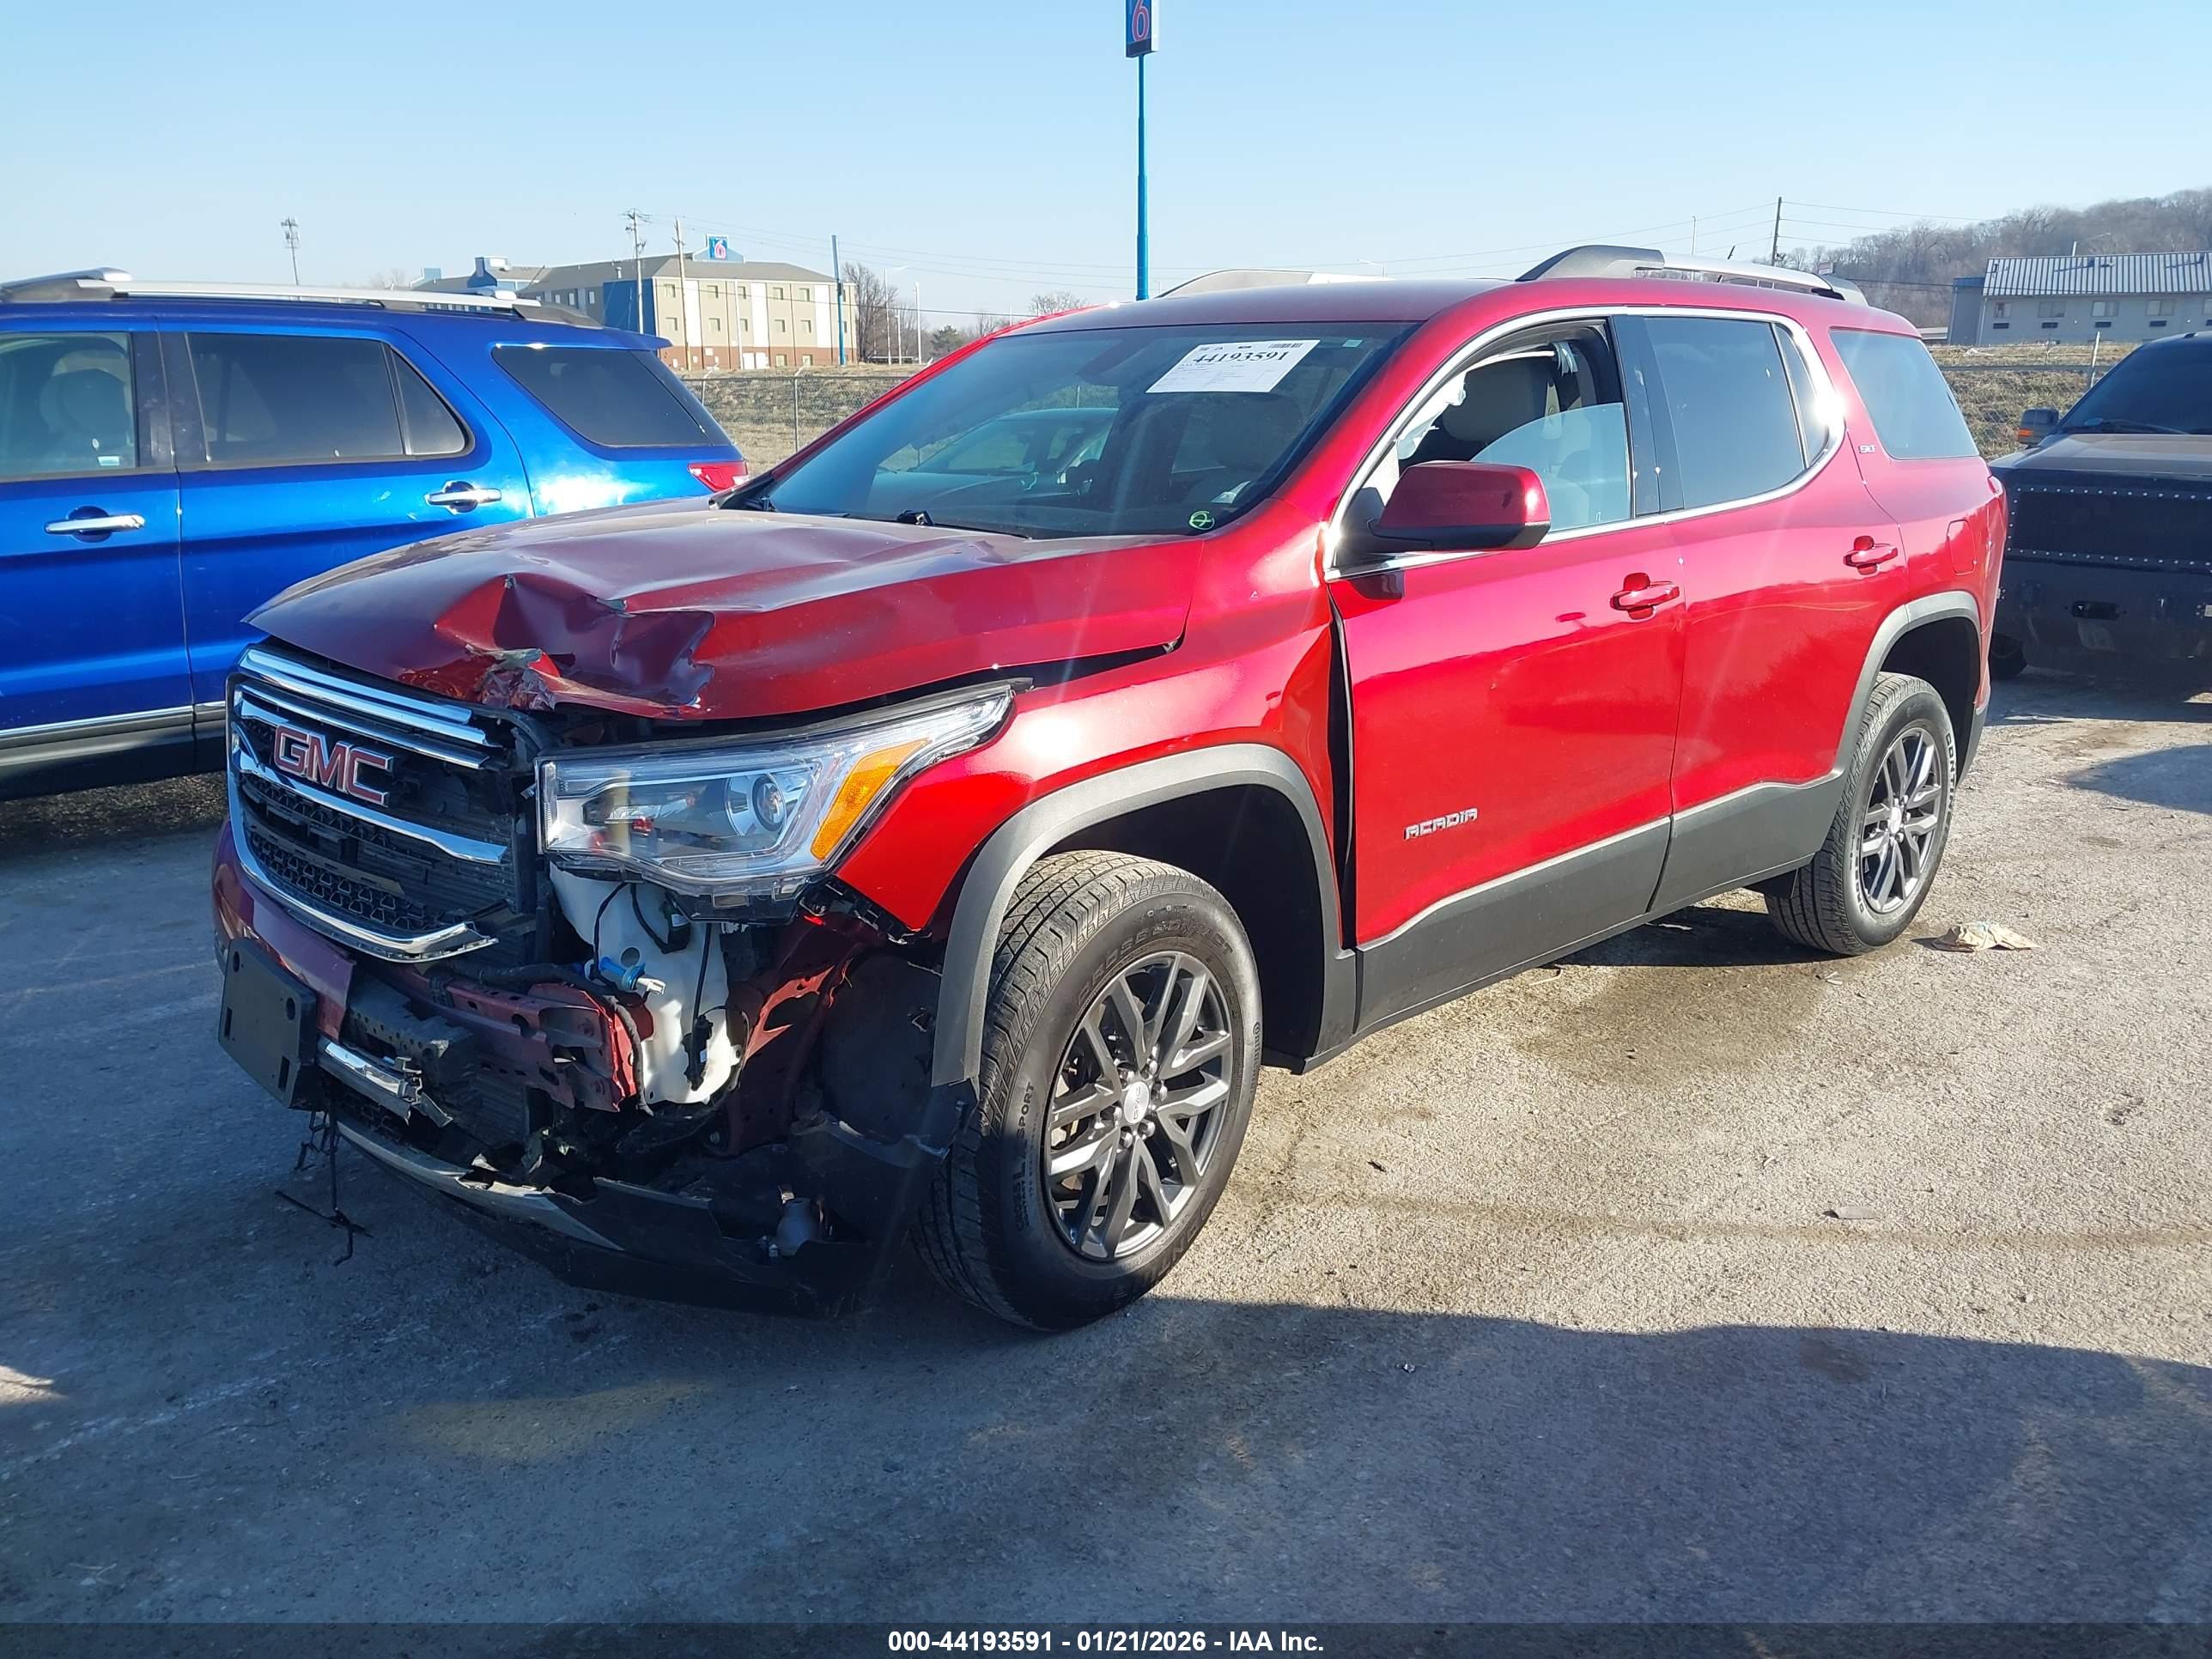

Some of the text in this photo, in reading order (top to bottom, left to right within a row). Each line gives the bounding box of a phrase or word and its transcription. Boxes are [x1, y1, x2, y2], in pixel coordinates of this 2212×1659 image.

[1132, 0, 1150, 41] 6
[714, 239, 726, 259] 6
[1192, 350, 1290, 363] 44193591
[273, 723, 395, 807] GMC
[1403, 807, 1480, 841] ACADIA
[1016, 1080, 1036, 1140] SPORT
